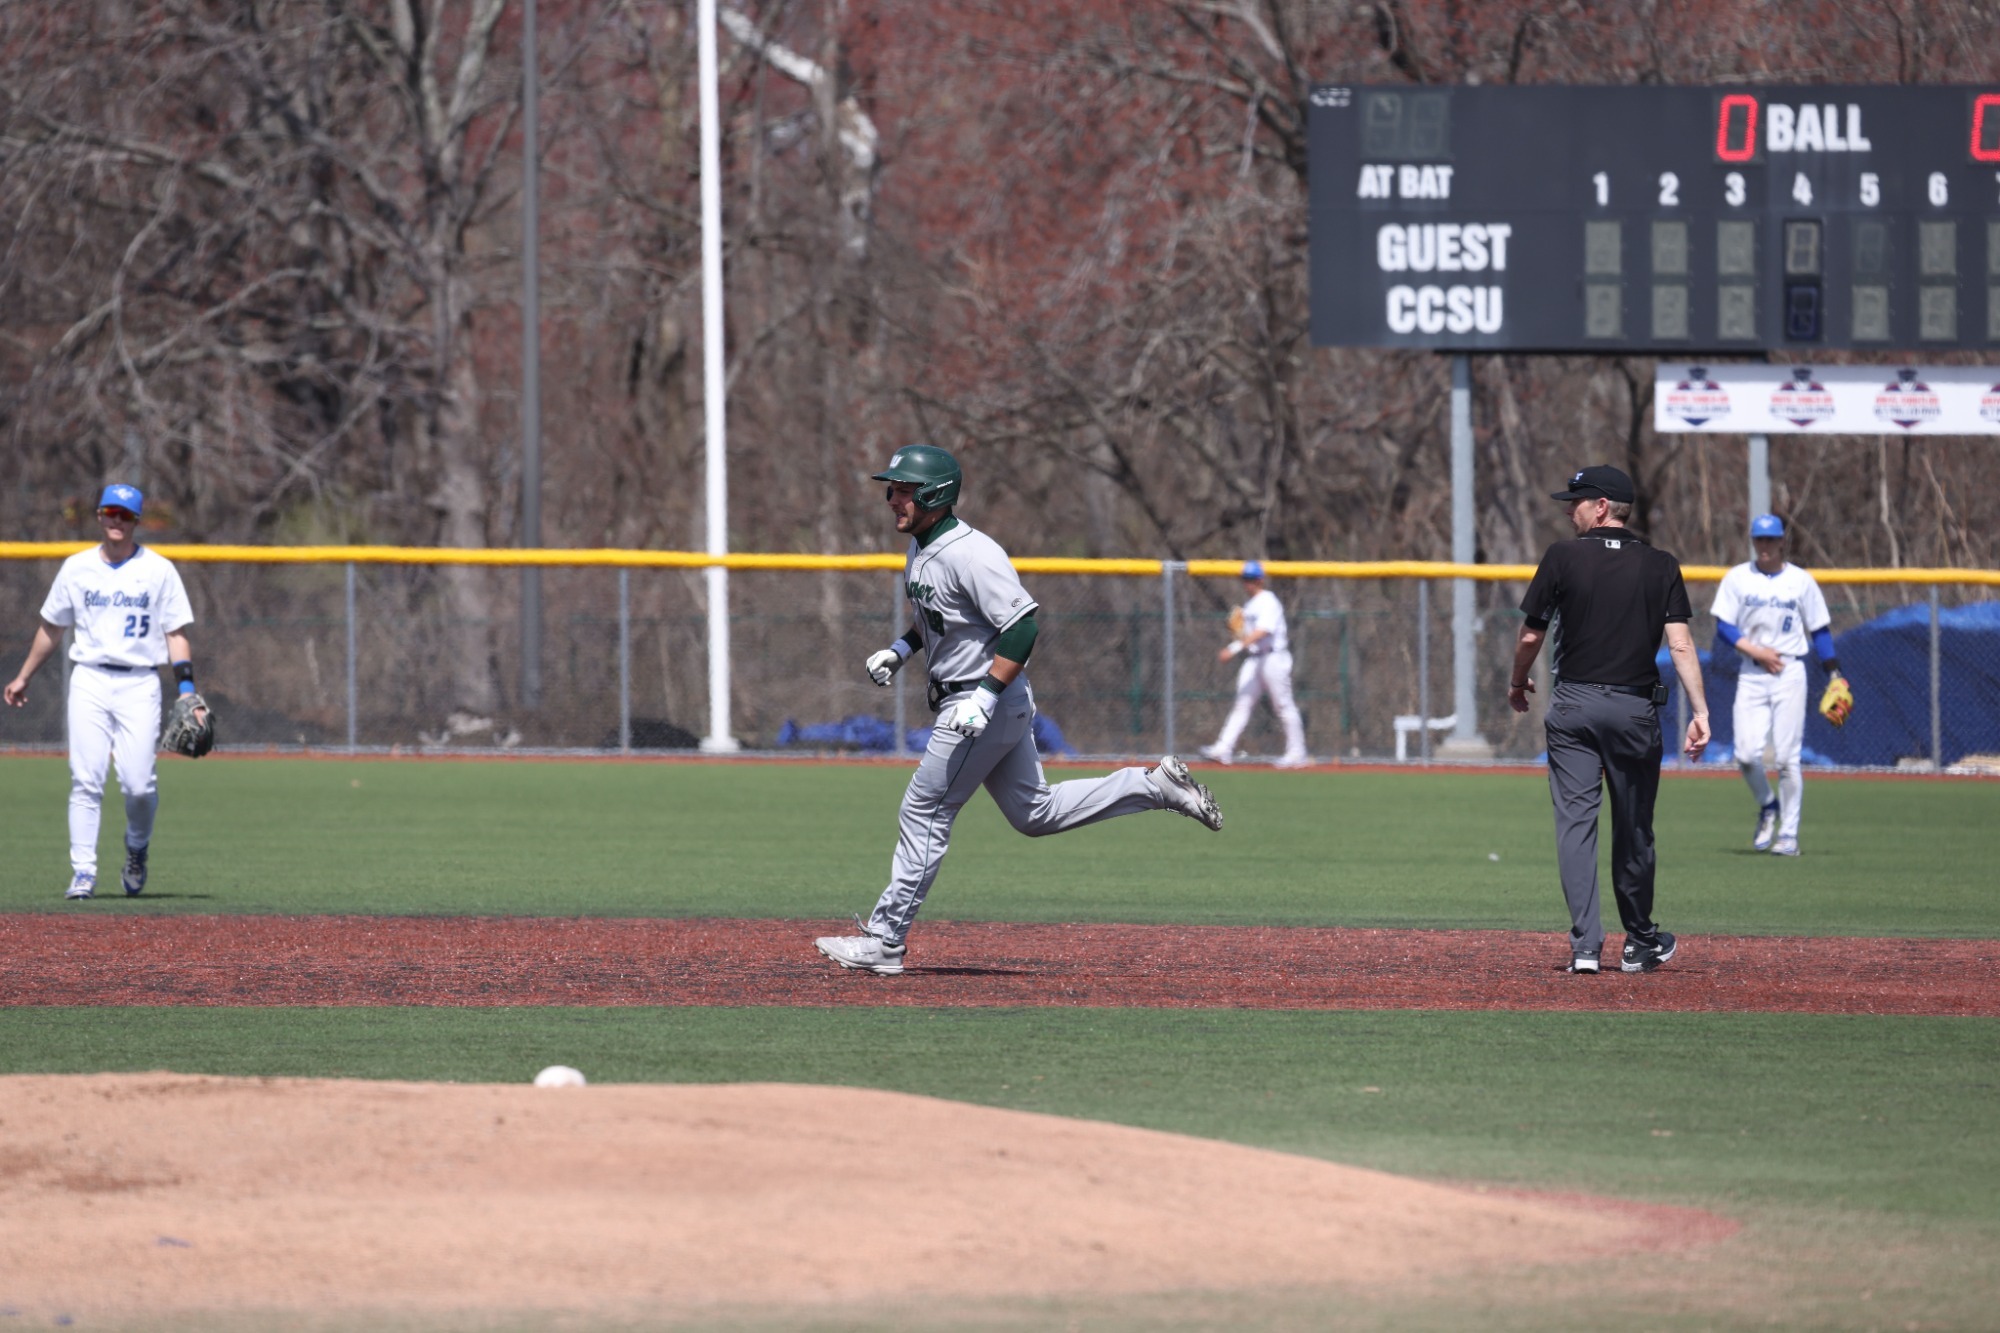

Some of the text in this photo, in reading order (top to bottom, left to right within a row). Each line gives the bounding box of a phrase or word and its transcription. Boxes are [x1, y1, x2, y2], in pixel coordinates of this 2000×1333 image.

[1716, 94, 1758, 162] 0
[1766, 103, 1872, 152] BALL
[1356, 163, 1454, 199] AT BAT
[1592, 171, 1949, 207] 1 2 3 4 5 6
[1376, 222, 1512, 272] GUEST
[1386, 284, 1503, 334] CCSU
[84, 589, 150, 610] Blue Devils
[124, 614, 150, 639] 25
[1782, 615, 1793, 634] 6
